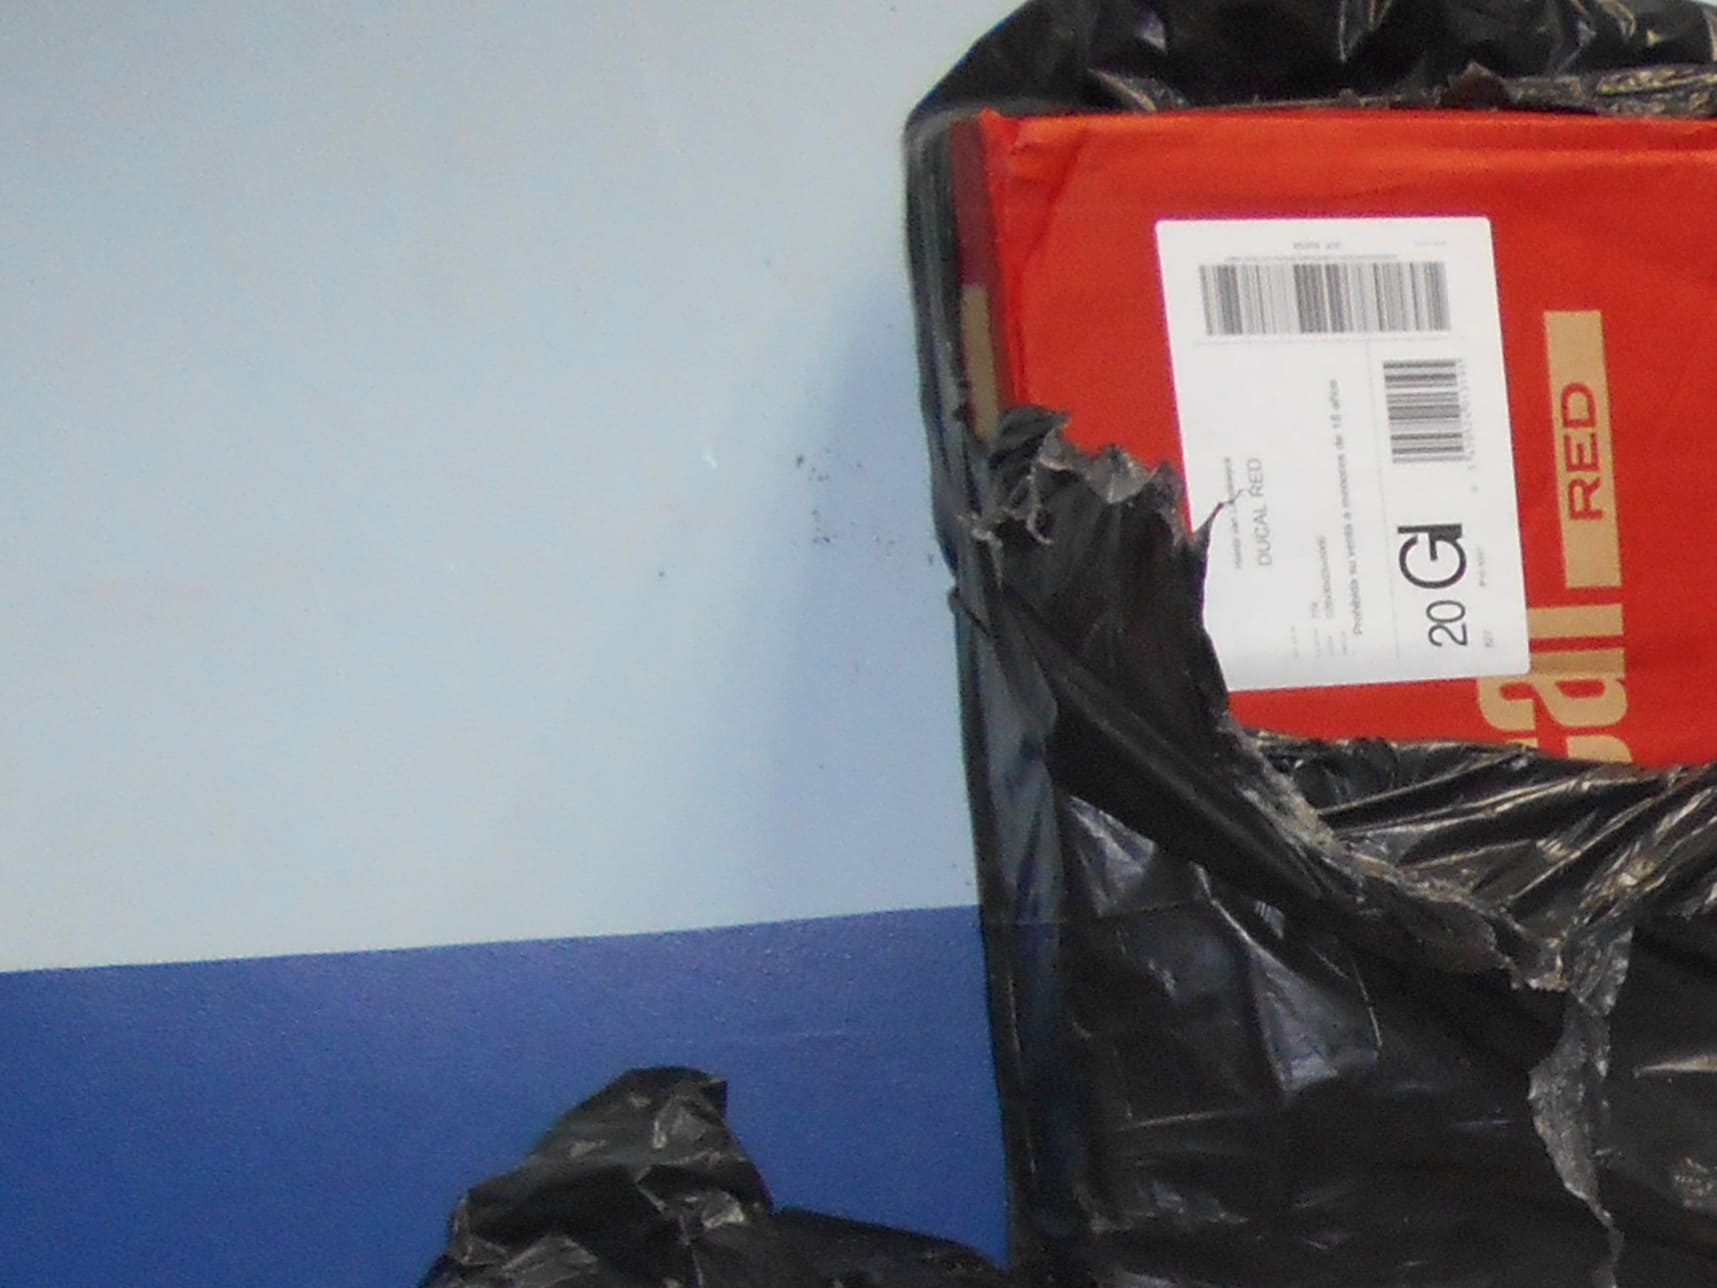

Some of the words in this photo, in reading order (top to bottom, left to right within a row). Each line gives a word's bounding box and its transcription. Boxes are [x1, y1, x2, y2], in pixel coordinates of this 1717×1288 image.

[1246, 457, 1265, 498] RED
[1561, 382, 1603, 523] RED
[1252, 504, 1273, 567] DUCAL
[1427, 600, 1468, 648] 20
